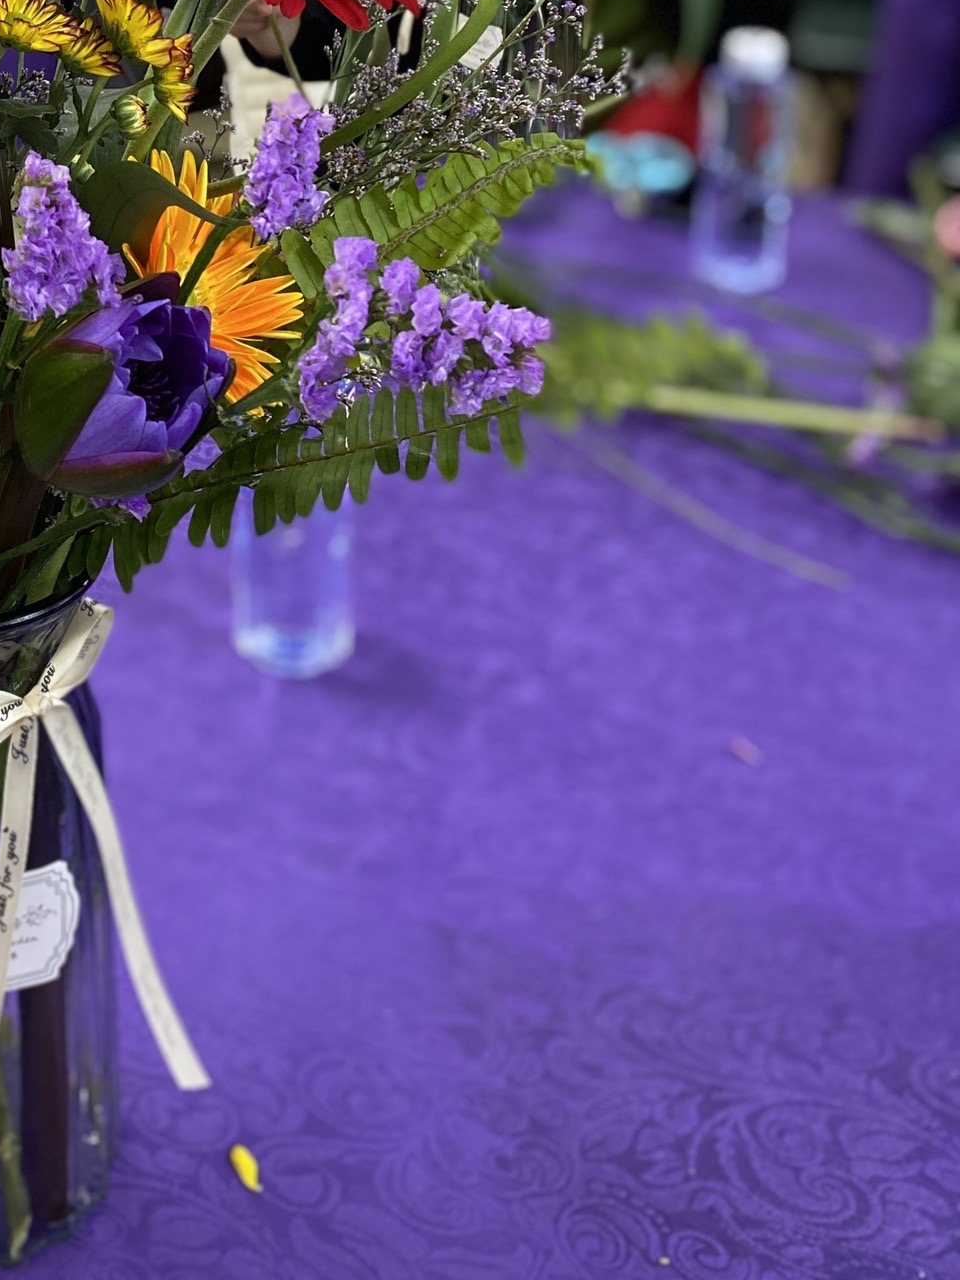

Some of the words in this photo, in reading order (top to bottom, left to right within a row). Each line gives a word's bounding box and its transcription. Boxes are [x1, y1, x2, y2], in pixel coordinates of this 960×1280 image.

[41, 664, 56, 693] you
[0, 700, 23, 721] you
[11, 725, 29, 764] Just
[7, 831, 19, 865] you
